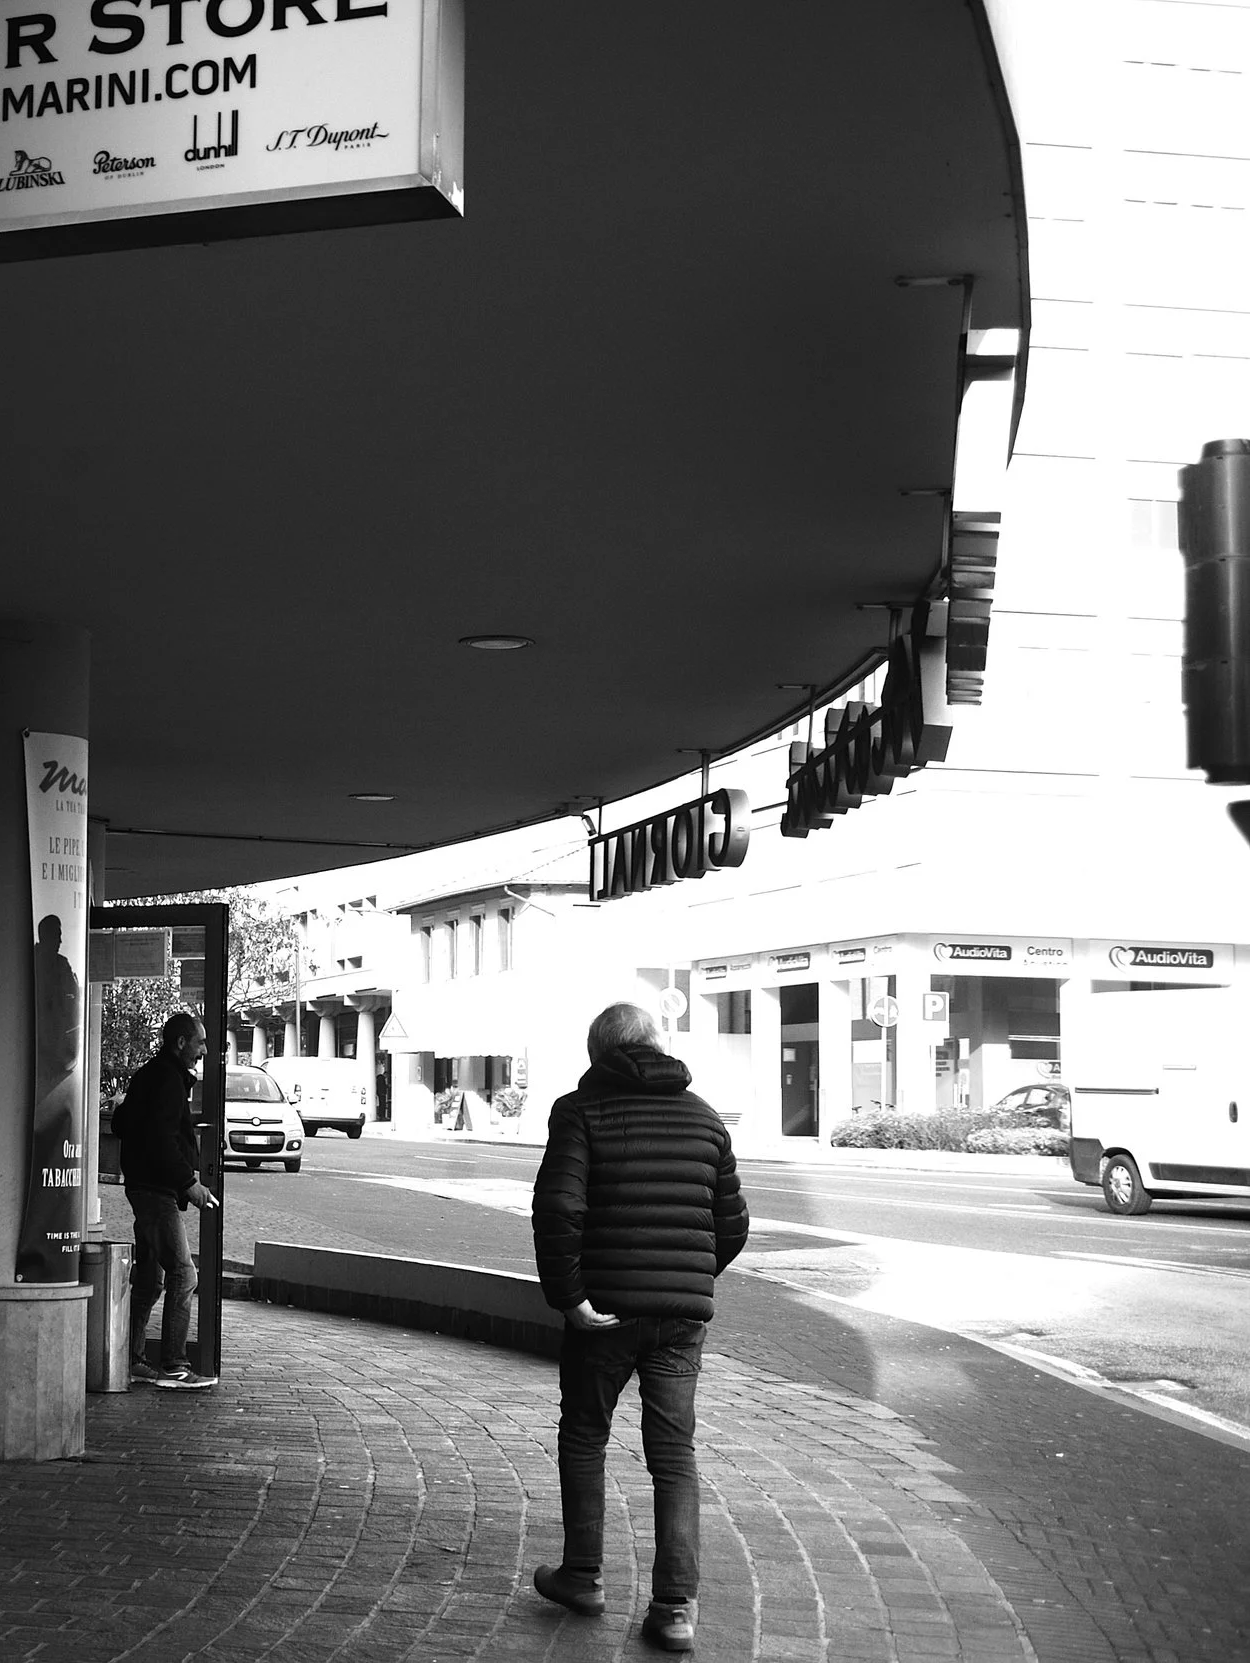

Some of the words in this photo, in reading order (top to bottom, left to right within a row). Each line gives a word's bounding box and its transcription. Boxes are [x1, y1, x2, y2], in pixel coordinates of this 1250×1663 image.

[184, 109, 239, 162] dunhill
[307, 121, 390, 152] Dupont
[344, 142, 371, 150] PARIS
[92, 150, 156, 175] Peterson
[196, 163, 225, 171] LONDON
[49, 836, 60, 854] LE
[63, 838, 81, 857] PIPE
[42, 862, 48, 880] E
[50, 863, 55, 881] I
[952, 944, 1008, 960] AudioVita
[1027, 946, 1063, 958] Centro
[1135, 949, 1208, 966] AudioVita
[924, 993, 945, 1020] P
[46, 1232, 63, 1240] TIME
[63, 1231, 70, 1240] IS
[61, 1245, 73, 1253] FILL
